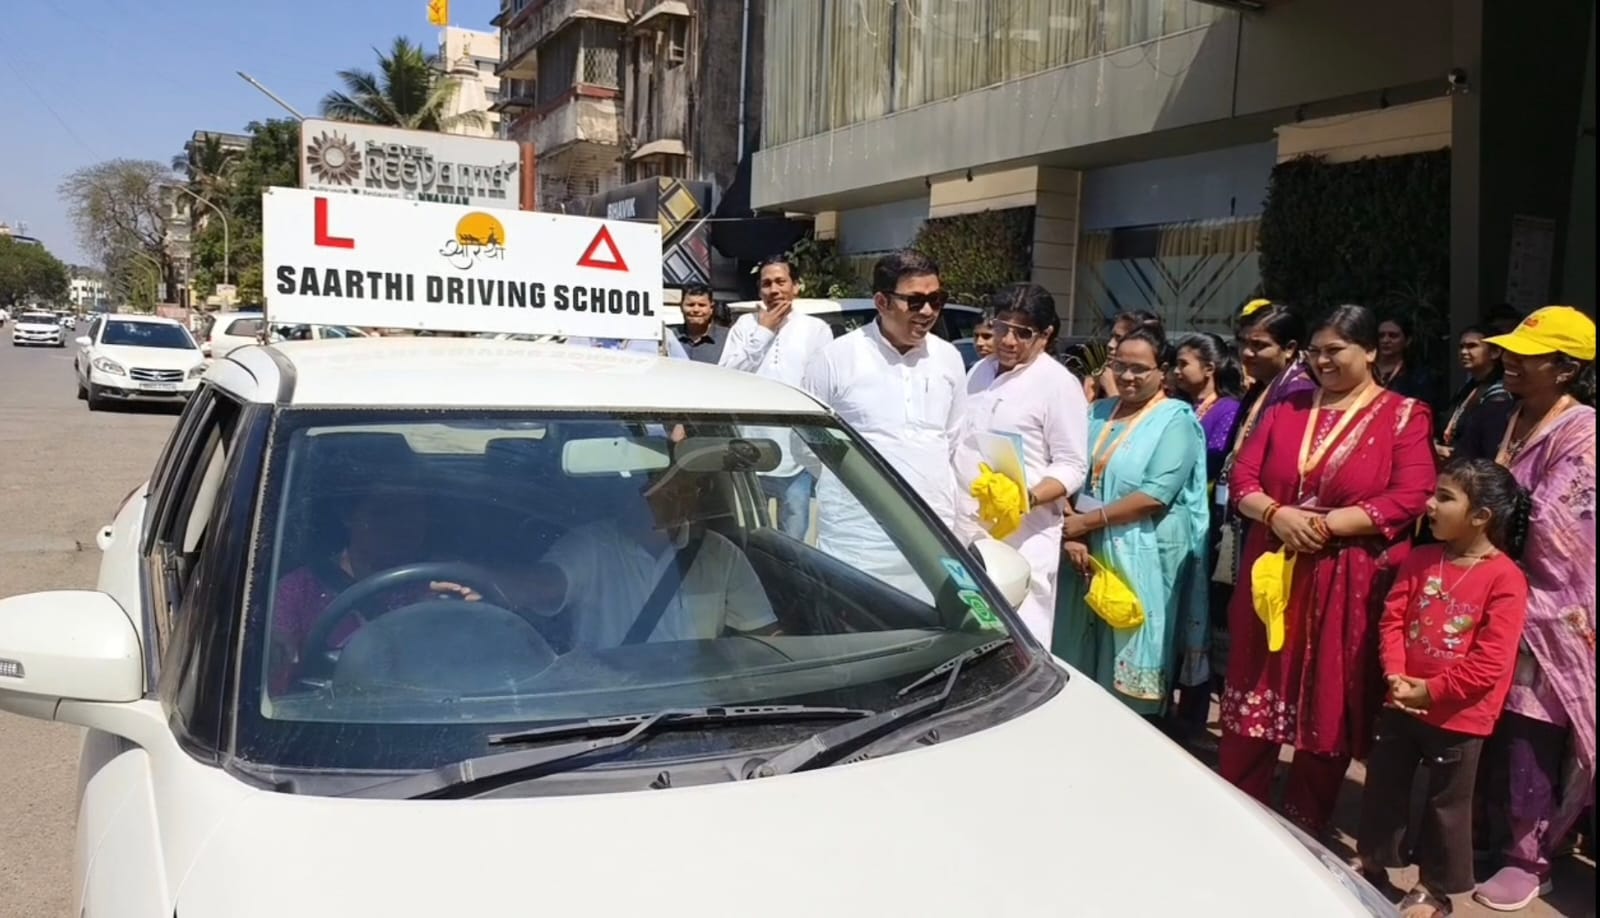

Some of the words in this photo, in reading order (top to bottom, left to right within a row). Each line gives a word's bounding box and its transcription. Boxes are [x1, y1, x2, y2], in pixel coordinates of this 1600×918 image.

[315, 197, 355, 250] L
[276, 265, 414, 302] SAARTHI
[426, 274, 546, 309] DRIVING
[554, 284, 655, 317] SCHOOL
